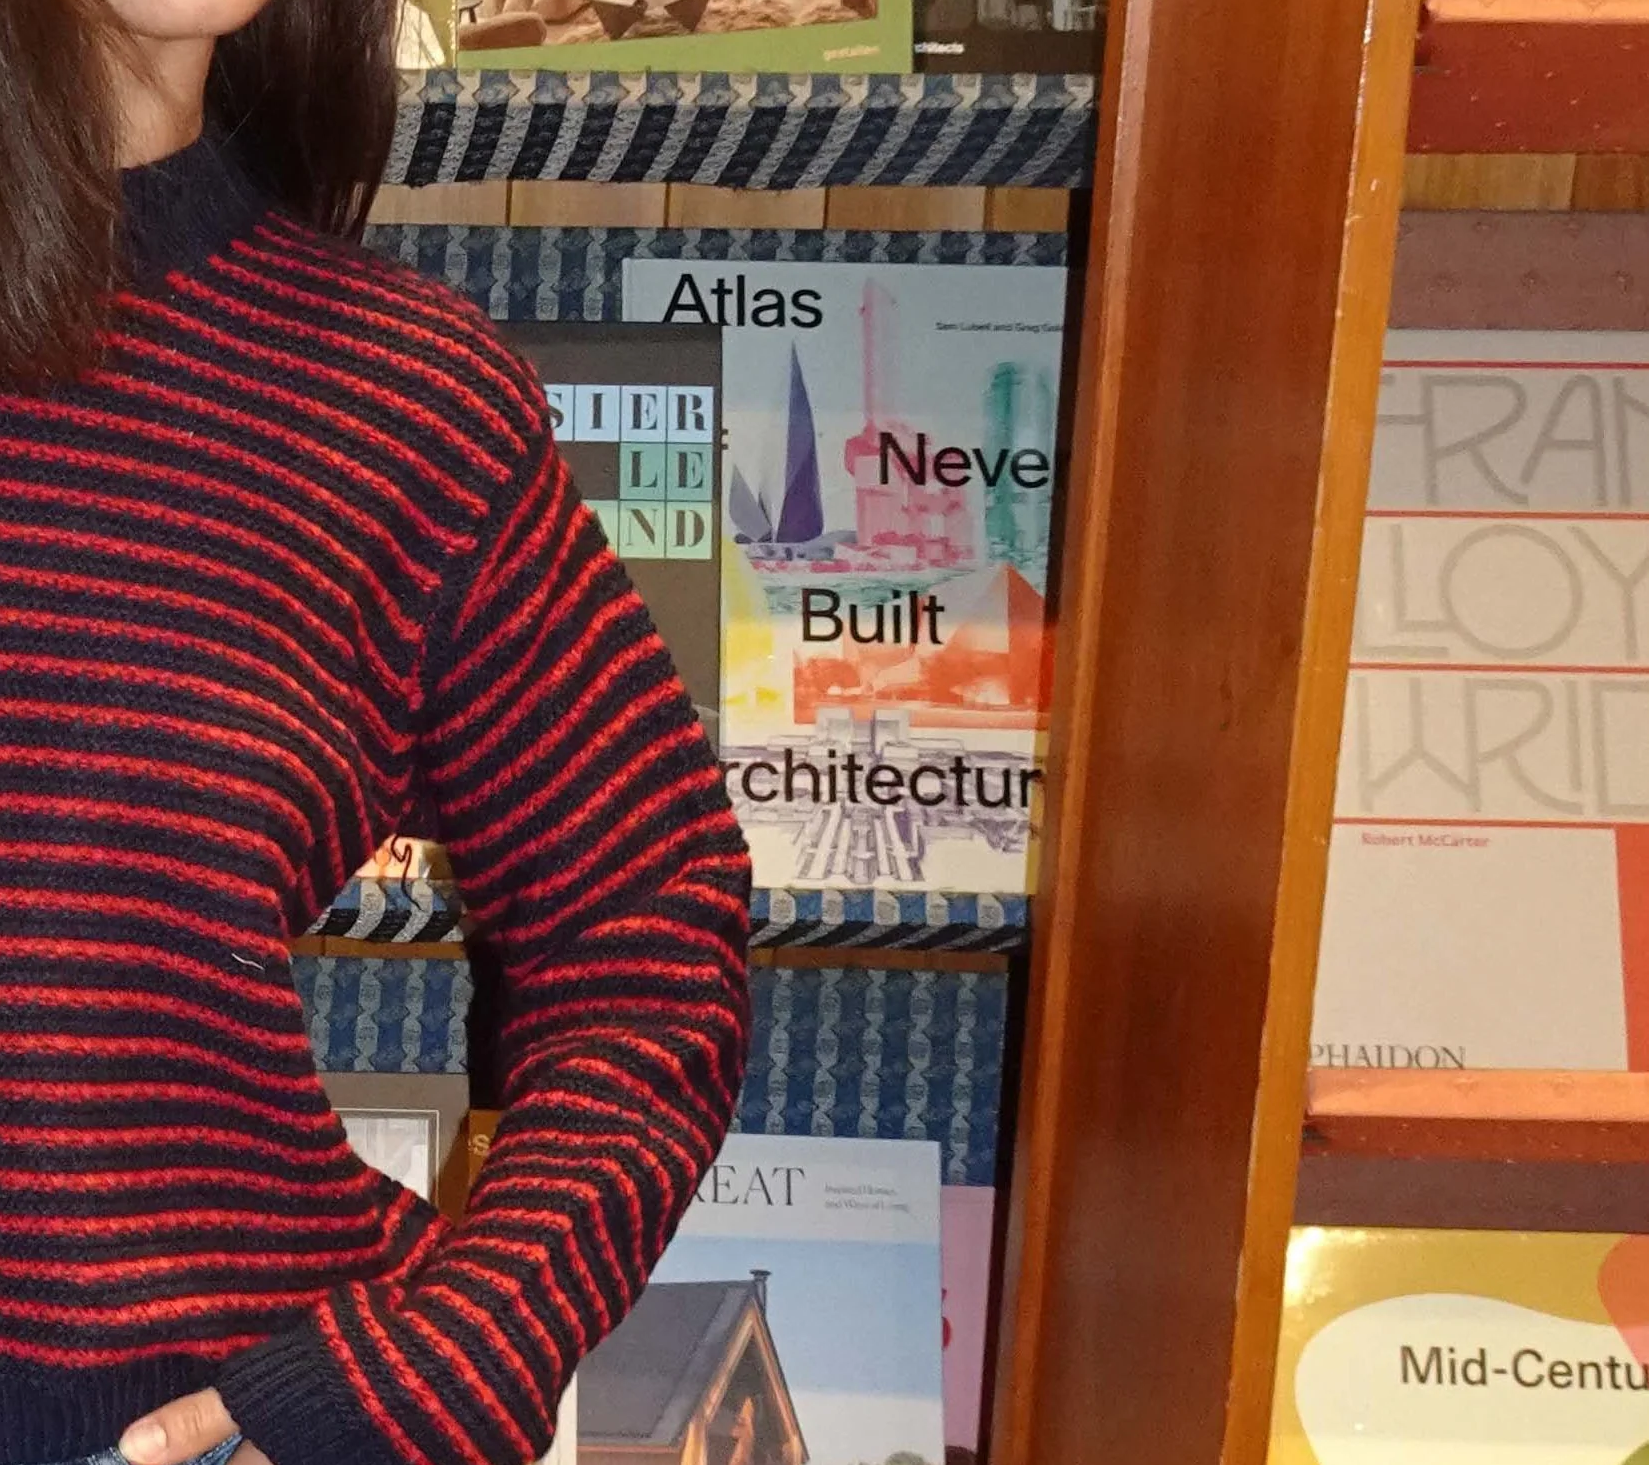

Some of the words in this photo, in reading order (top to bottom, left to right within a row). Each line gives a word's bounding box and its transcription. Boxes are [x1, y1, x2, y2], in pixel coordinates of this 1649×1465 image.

[662, 273, 823, 327] Atlas
[629, 451, 705, 489] LE
[879, 433, 1050, 488] Neve
[803, 589, 945, 644] Built
[1361, 832, 1414, 846] Robert
[1418, 833, 1490, 847] McCarter
[1312, 1043, 1467, 1070] PHAIDON
